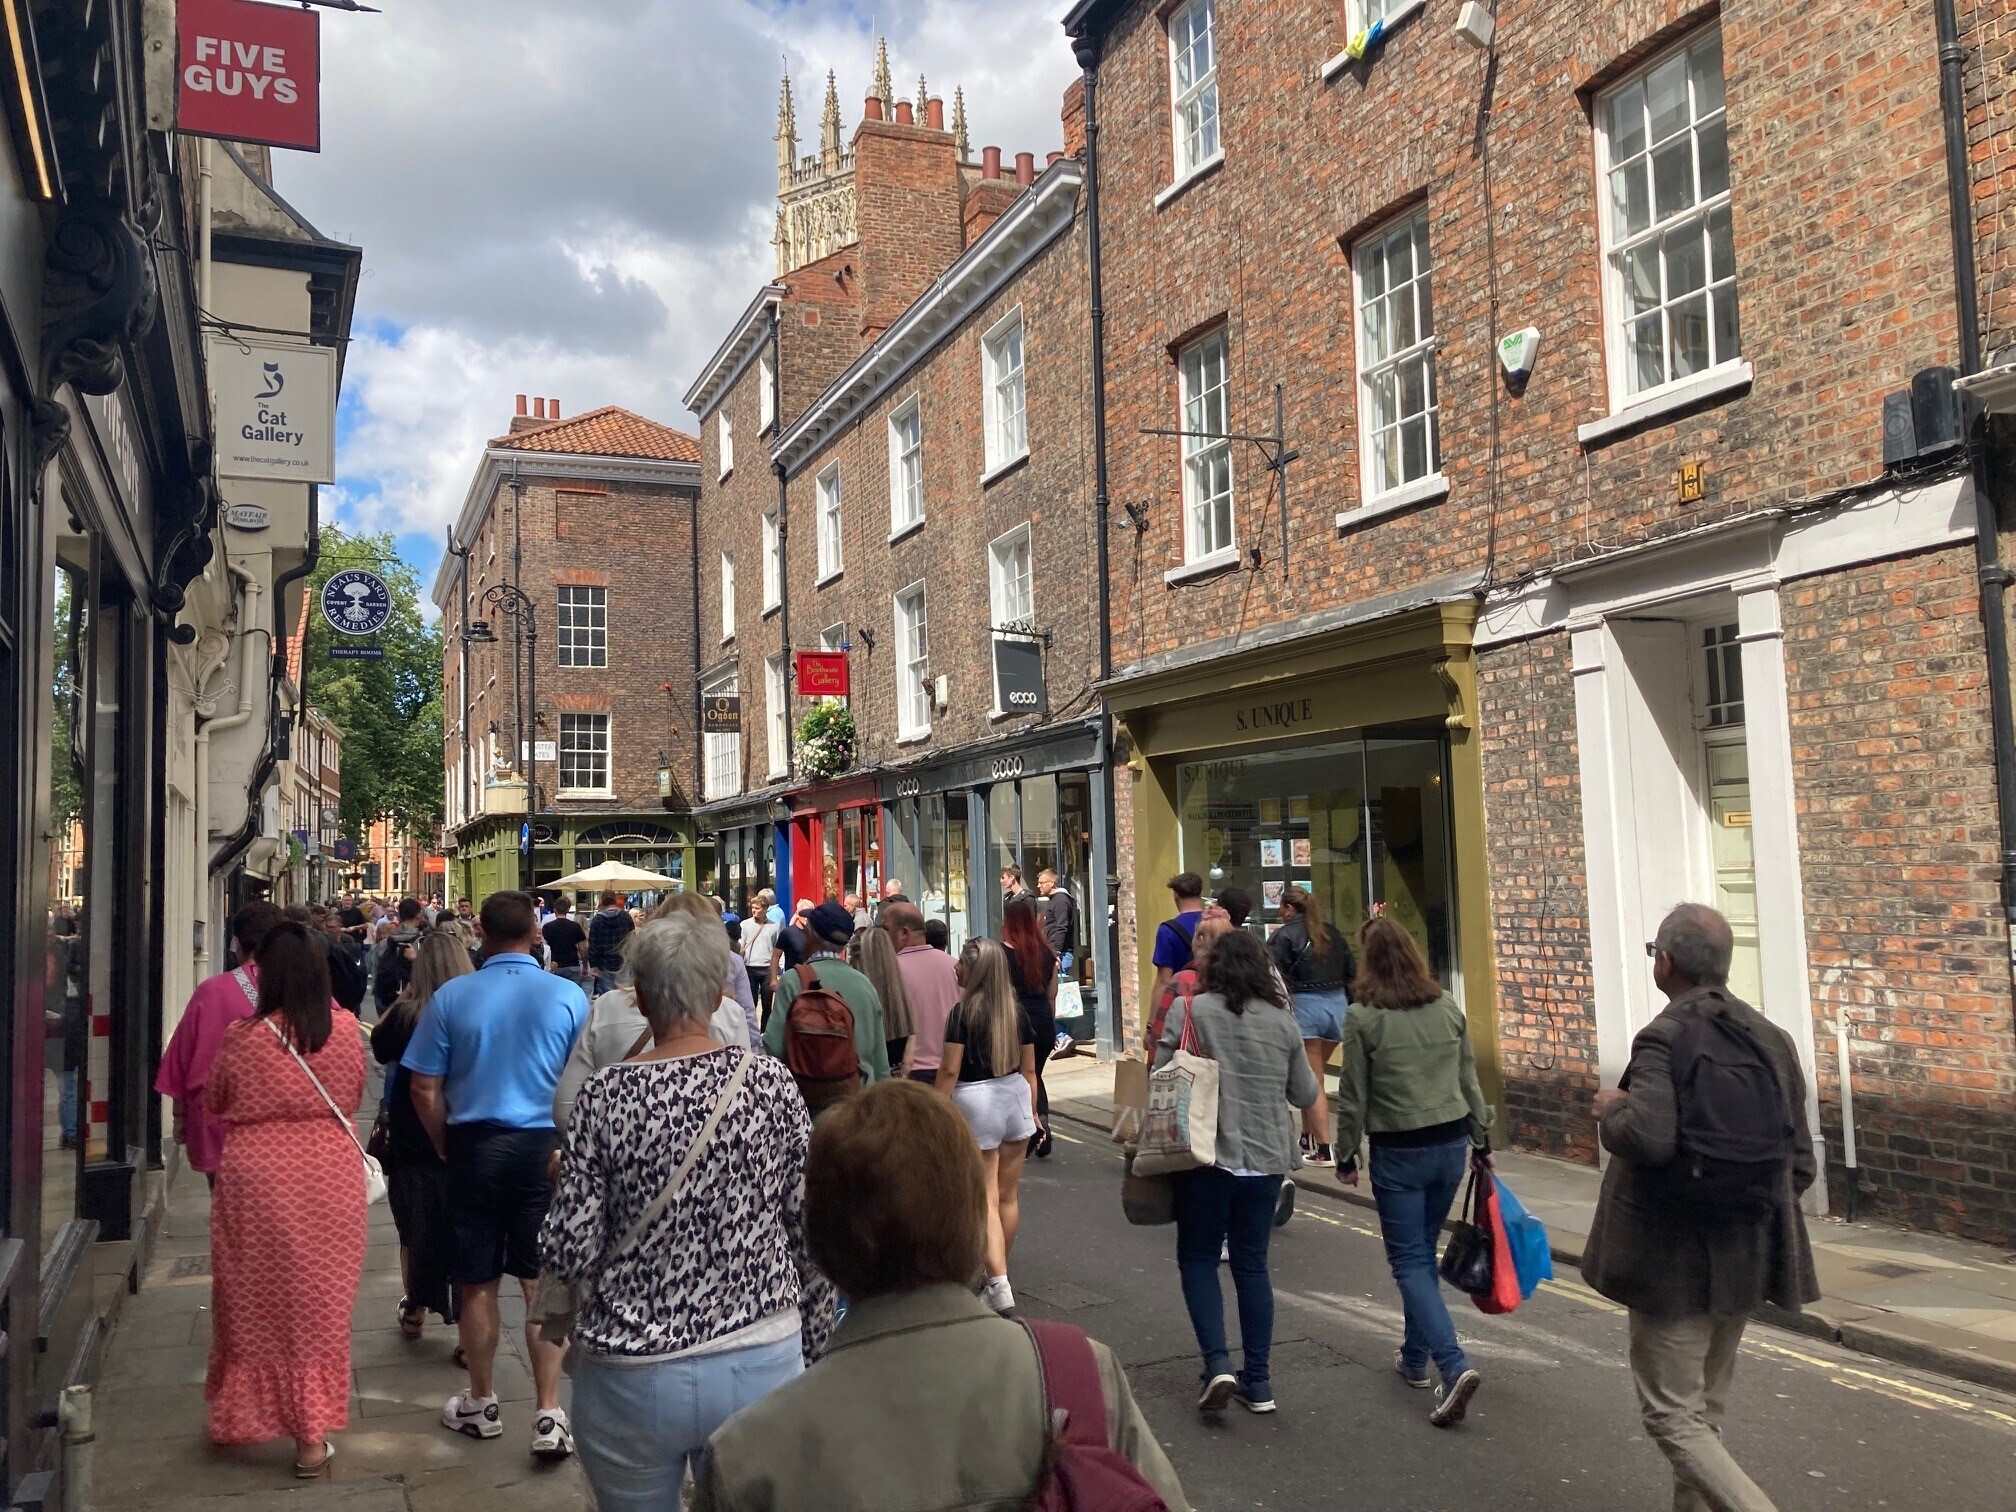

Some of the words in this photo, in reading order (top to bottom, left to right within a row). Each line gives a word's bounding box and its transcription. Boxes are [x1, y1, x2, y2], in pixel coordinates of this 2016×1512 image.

[196, 36, 286, 74] FIVE
[184, 65, 298, 104] GUYS
[257, 409, 287, 426] Cat
[241, 425, 304, 447] Gallery
[233, 455, 310, 467] www.thecatgallery.co.uk
[230, 510, 268, 519] MAYFAIR
[327, 573, 360, 598] NEAL'S
[363, 575, 387, 600] YARD
[328, 608, 385, 630] REMEDIES
[811, 673, 840, 688] Gallery
[1009, 691, 1037, 704] ecco
[707, 709, 738, 722] Ogden
[1237, 711, 1248, 731] S.
[1251, 699, 1313, 728] UNIQUE
[991, 756, 1022, 779] ecco
[896, 777, 919, 797] ecco
